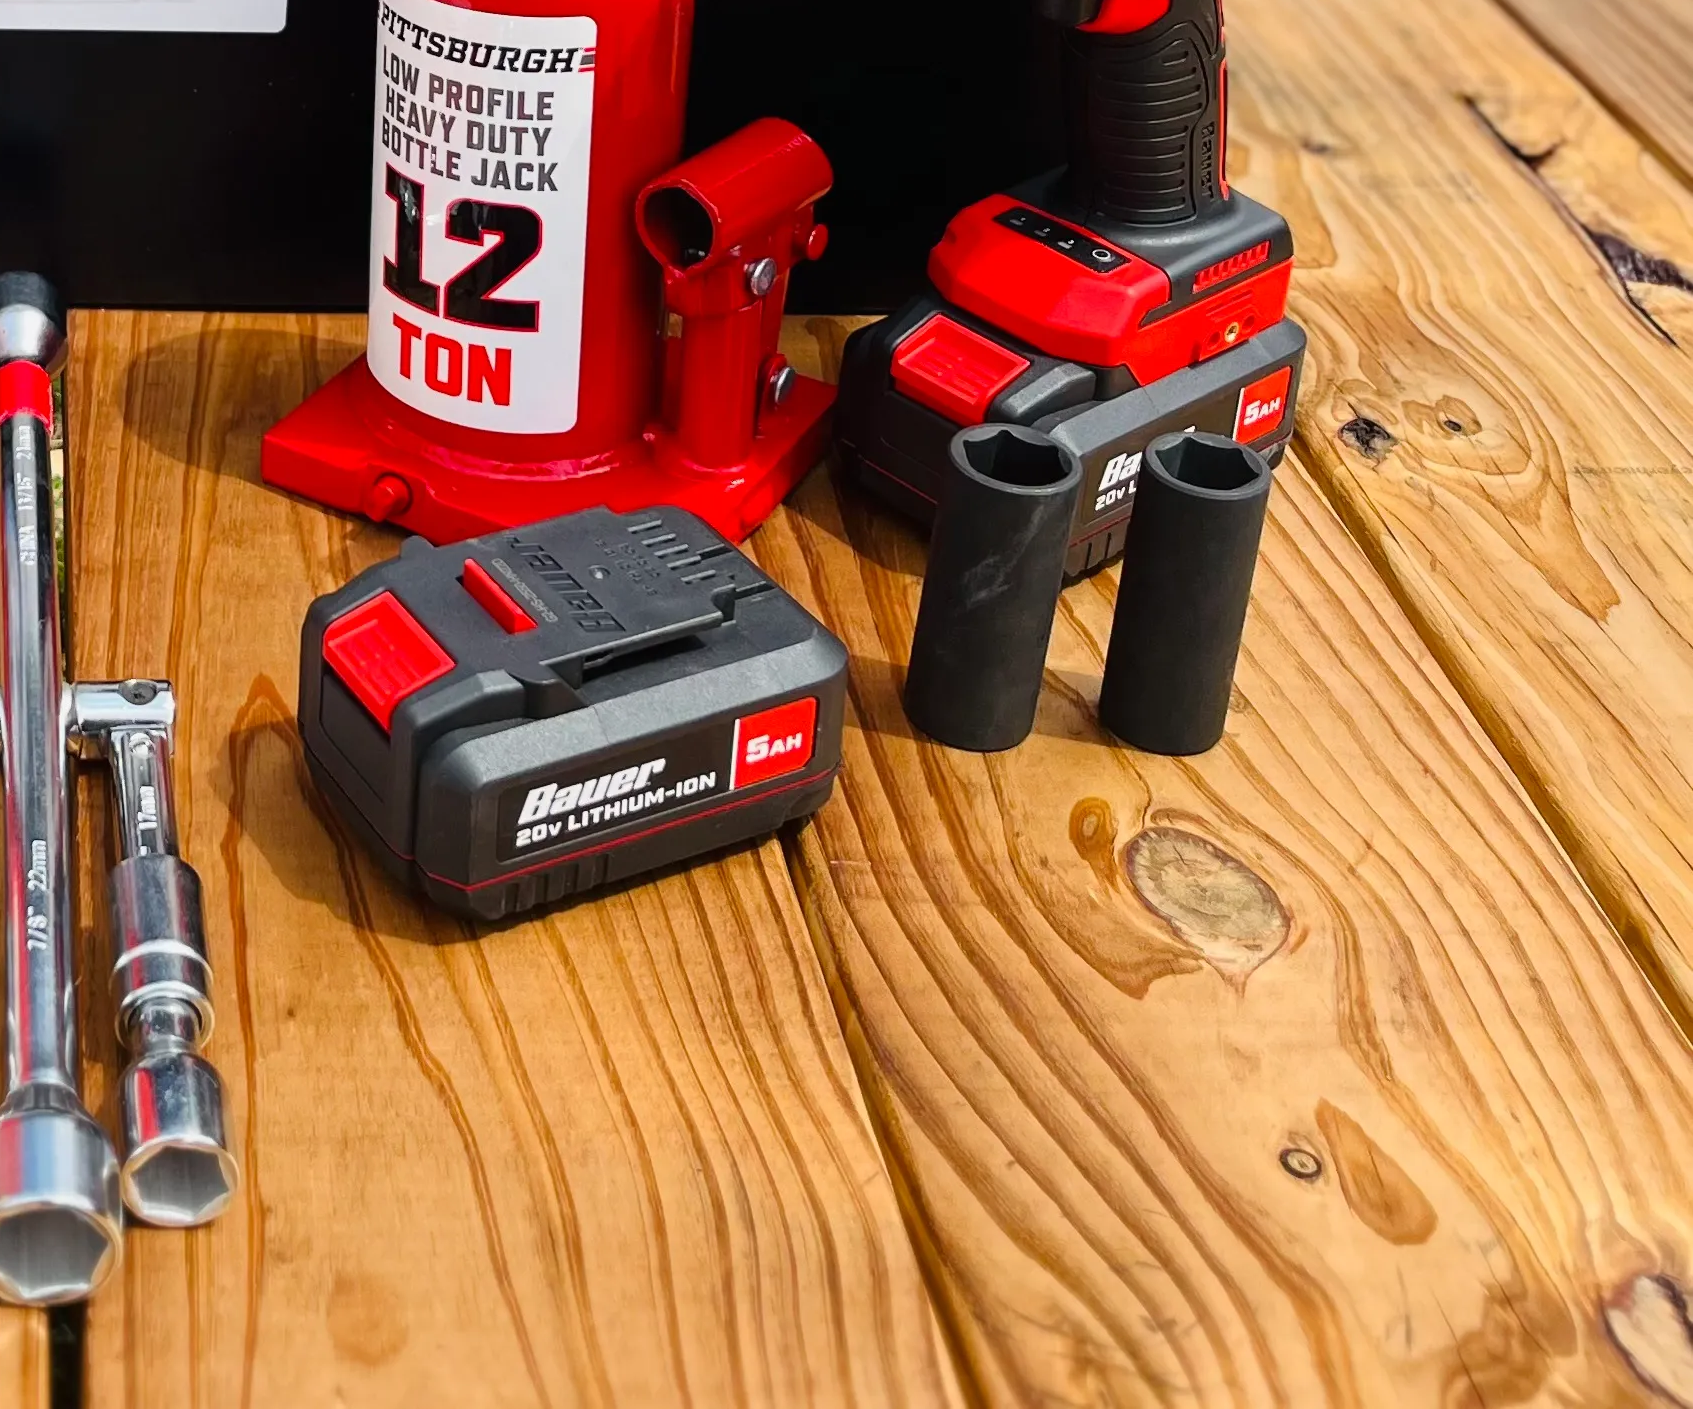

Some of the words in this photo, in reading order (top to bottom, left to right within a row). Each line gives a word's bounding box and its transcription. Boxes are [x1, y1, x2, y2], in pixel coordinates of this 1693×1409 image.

[380, 0, 580, 73] PITTSBURGH
[383, 44, 420, 96] LOW
[428, 72, 555, 121] PROFILE
[382, 116, 462, 181] BOTTLE
[470, 160, 559, 192] JACK
[385, 83, 456, 144] HEAVY
[466, 119, 553, 157] DUTY
[382, 161, 543, 333] 12
[392, 312, 513, 406] TON
[1243, 396, 1281, 426] 5AH
[745, 732, 802, 764] 5AH
[516, 757, 666, 826] Bauer
[567, 771, 717, 832] LITHIUM-ION
[26, 839, 49, 892] 22mm
